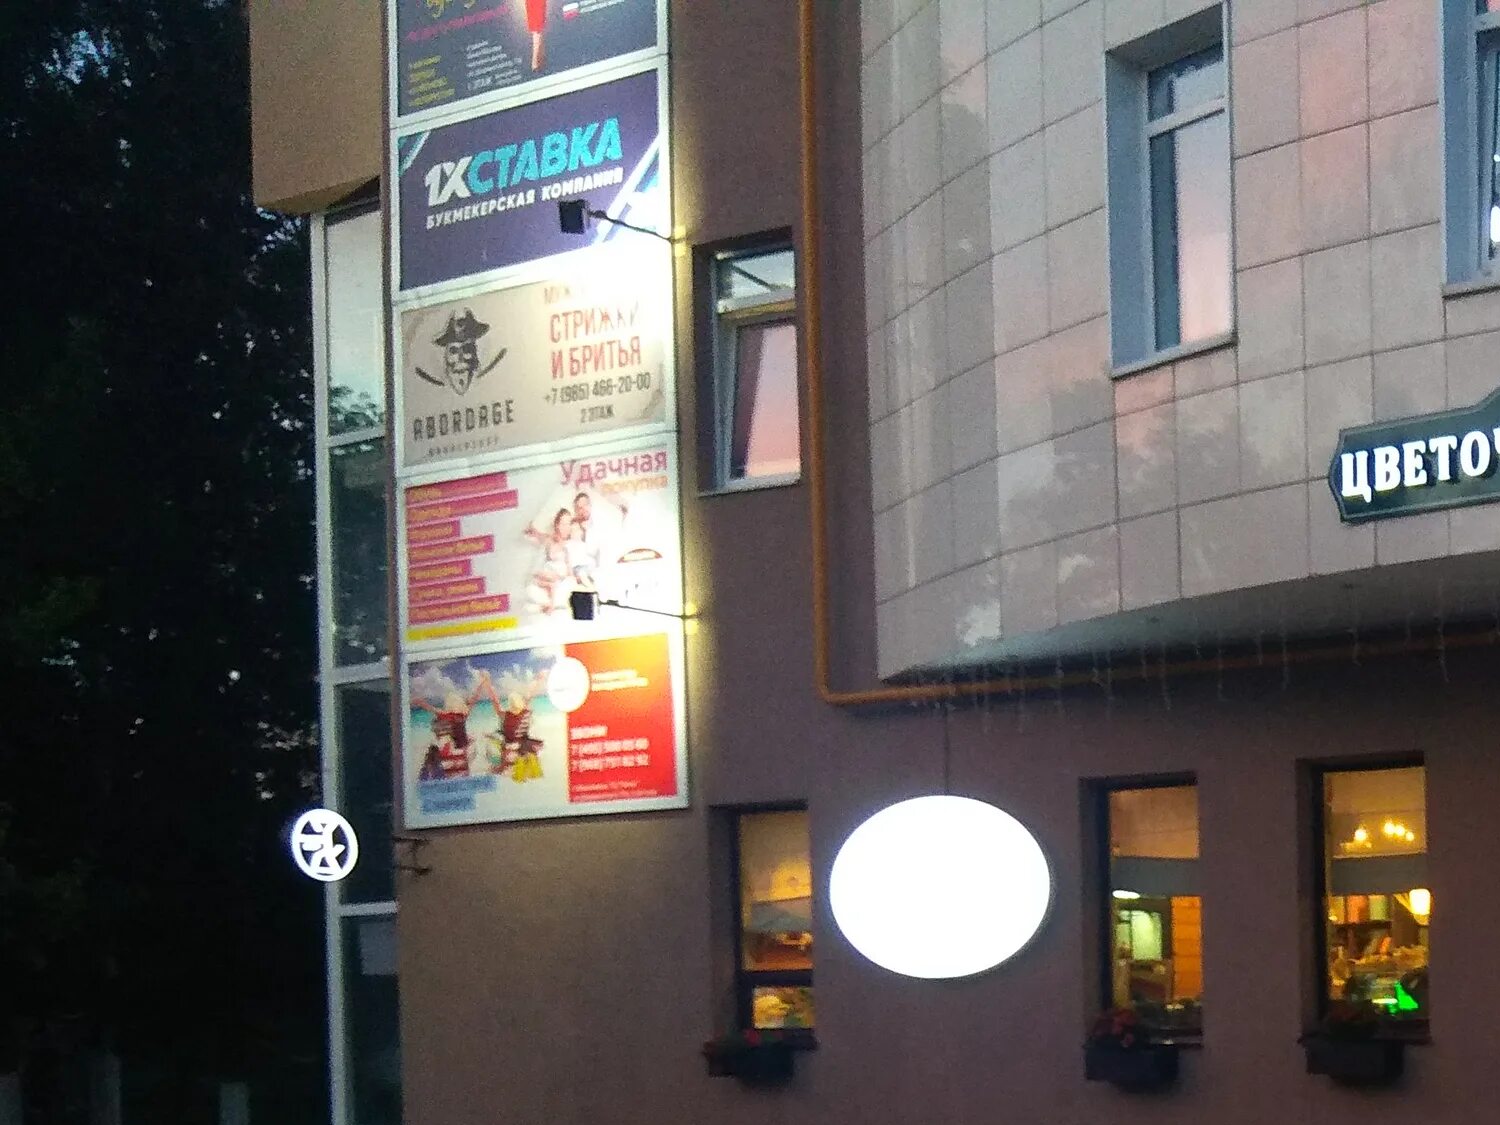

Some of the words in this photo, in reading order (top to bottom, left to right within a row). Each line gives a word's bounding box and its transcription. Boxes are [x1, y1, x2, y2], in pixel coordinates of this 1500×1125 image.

[426, 189, 535, 230] БУКМЕКЕРСКАЯ
[551, 349, 564, 380] И
[569, 335, 641, 376] БРИТЬЯ
[413, 399, 514, 440] ABORDAGE
[560, 451, 667, 488] Удачная
